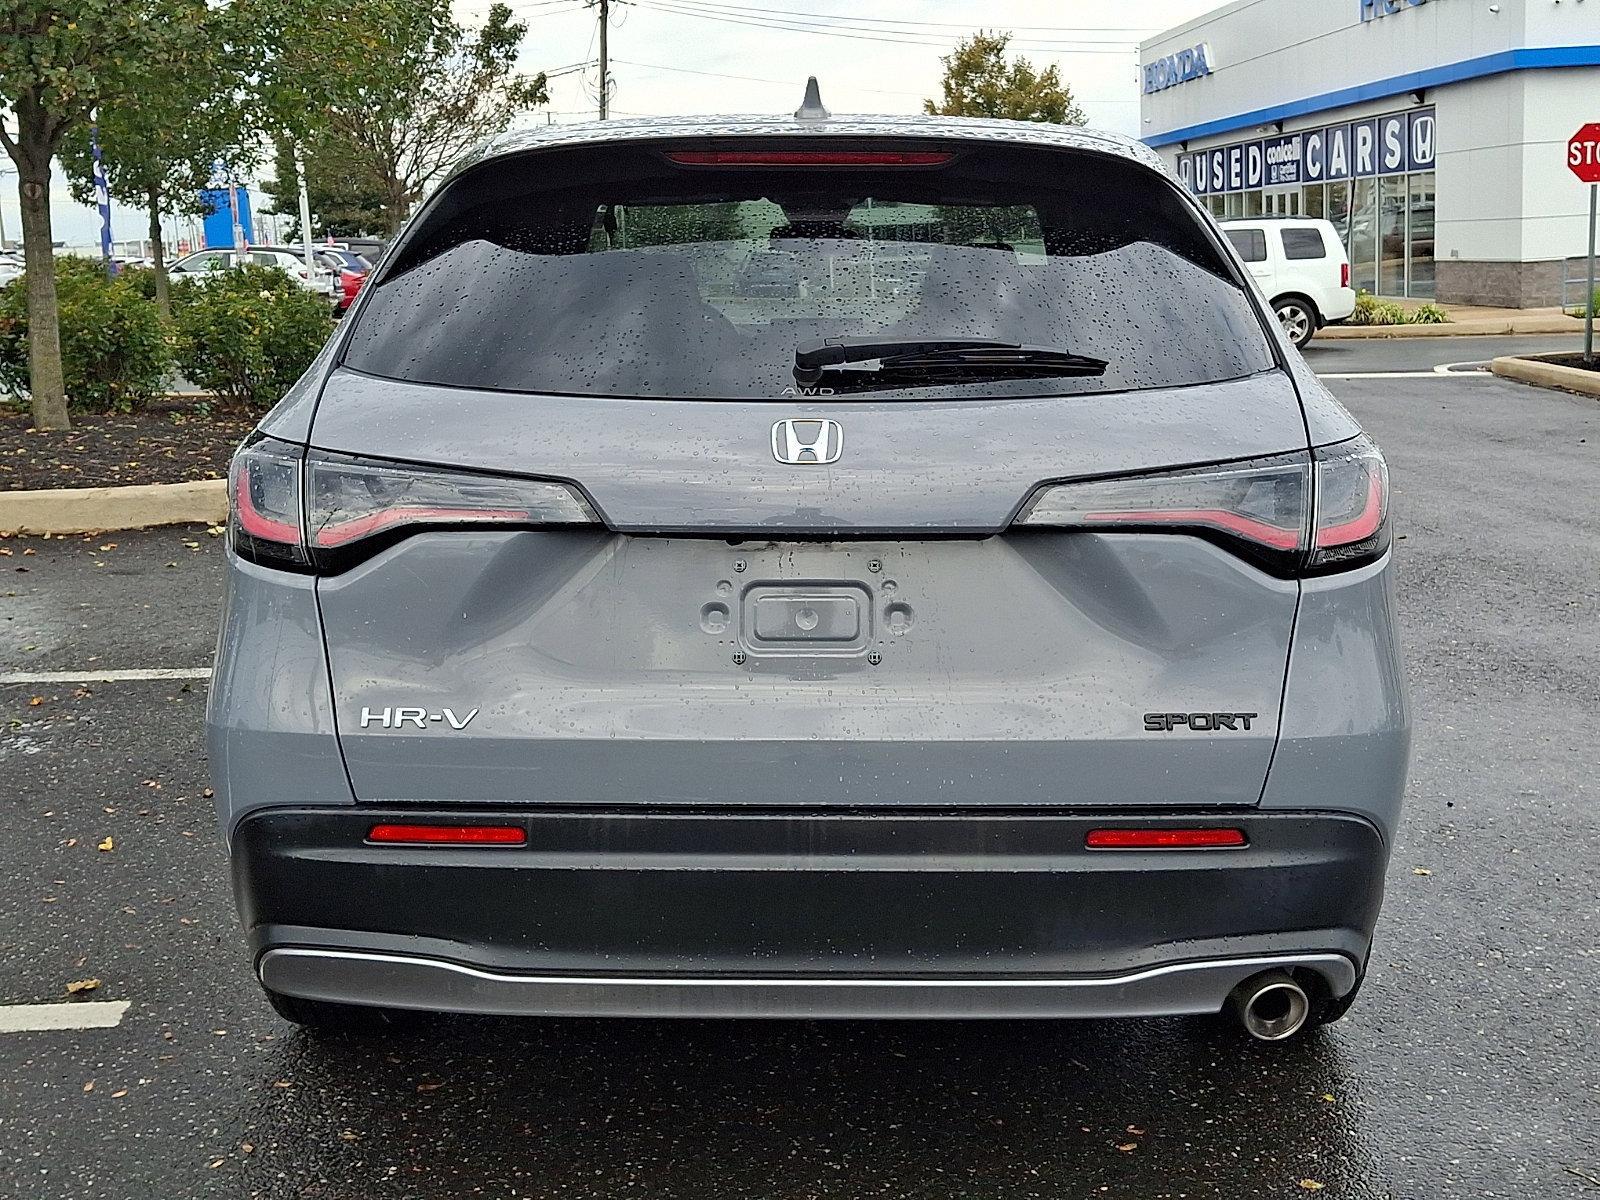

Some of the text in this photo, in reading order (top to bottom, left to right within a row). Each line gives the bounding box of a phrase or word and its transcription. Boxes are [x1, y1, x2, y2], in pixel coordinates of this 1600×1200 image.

[1143, 43, 1213, 95] HONDA
[1195, 119, 1401, 192] USED CARS
[780, 387, 835, 396] AWD
[360, 706, 479, 730] HR-V
[1143, 712, 1258, 731] SPORT
